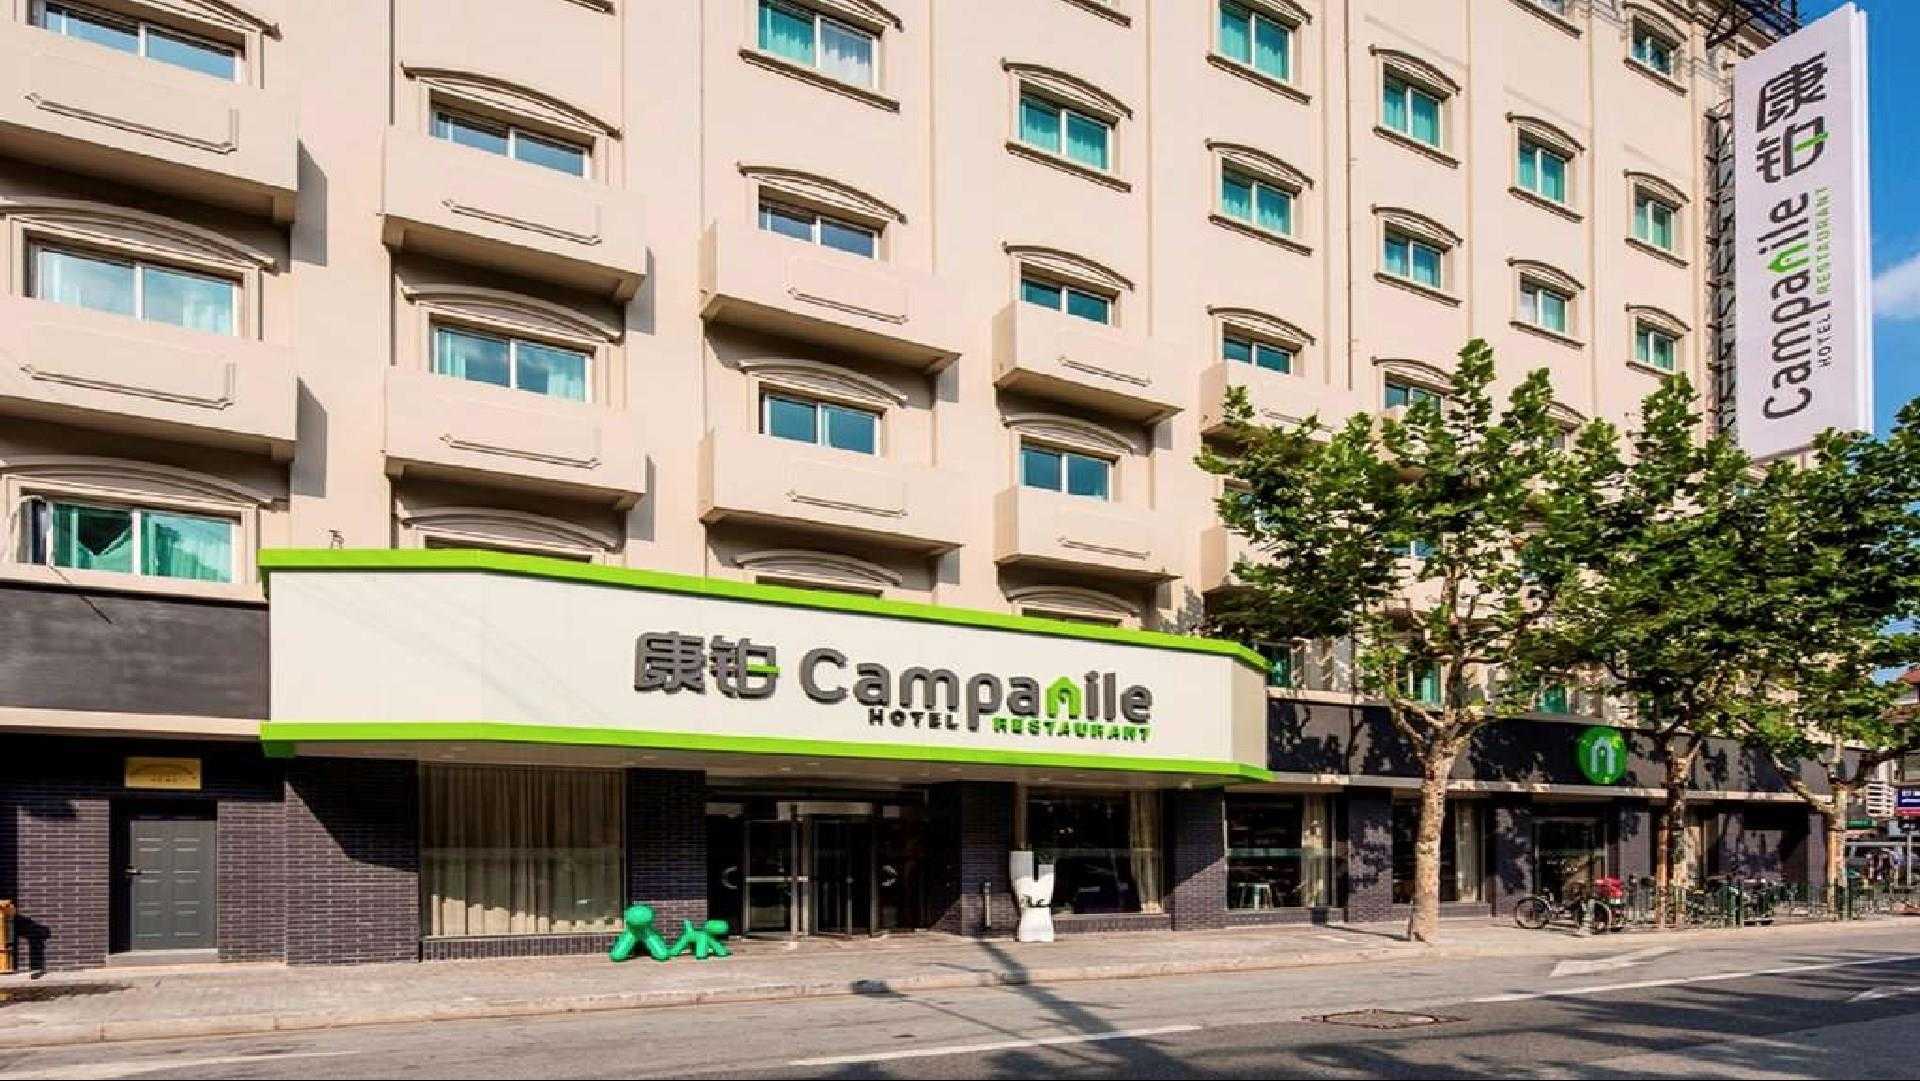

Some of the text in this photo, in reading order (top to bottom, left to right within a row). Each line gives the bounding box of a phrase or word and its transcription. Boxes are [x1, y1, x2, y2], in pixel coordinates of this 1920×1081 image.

[1757, 192, 1830, 421] Campanile
[1816, 186, 1833, 367] HOTEL RESTAURANT
[634, 631, 784, 700] 康铂
[799, 647, 1153, 733] Campanile
[868, 708, 1152, 743] HOTEL RESTAURANT
